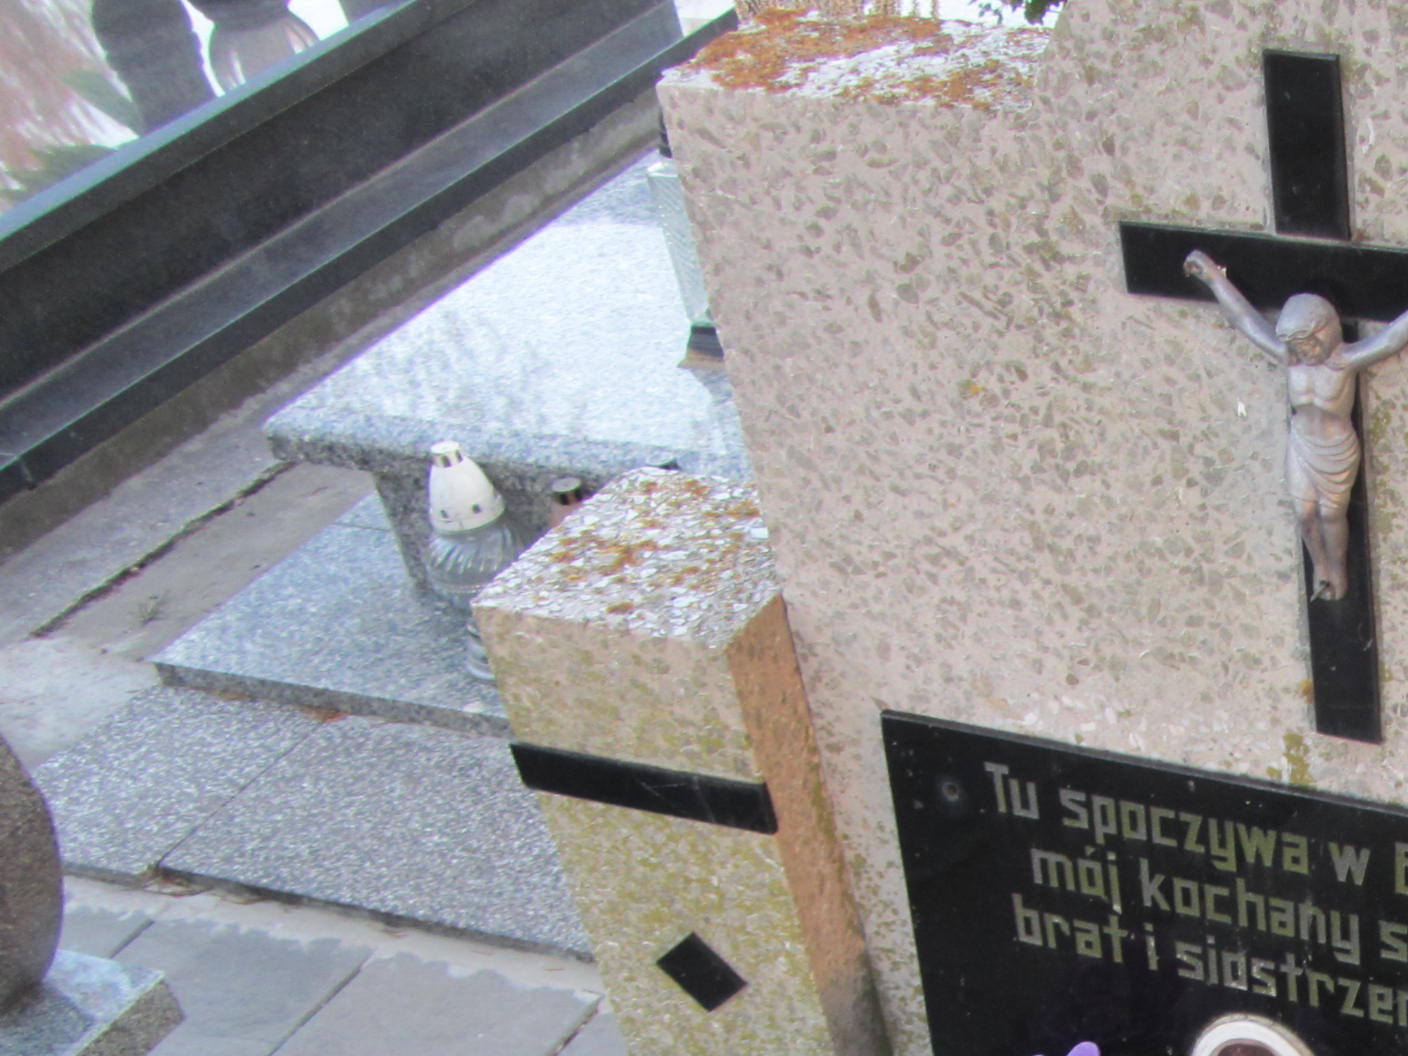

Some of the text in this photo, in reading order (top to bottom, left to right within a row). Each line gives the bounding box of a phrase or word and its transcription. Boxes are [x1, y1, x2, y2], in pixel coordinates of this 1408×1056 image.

[984, 761, 1039, 820] Tu
[1059, 787, 1310, 875] spoczywa
[1329, 840, 1371, 886] w
[1012, 892, 1129, 964] brat
[1144, 922, 1159, 971] i
[1030, 845, 1122, 915] mój
[1139, 857, 1361, 966] kochany
